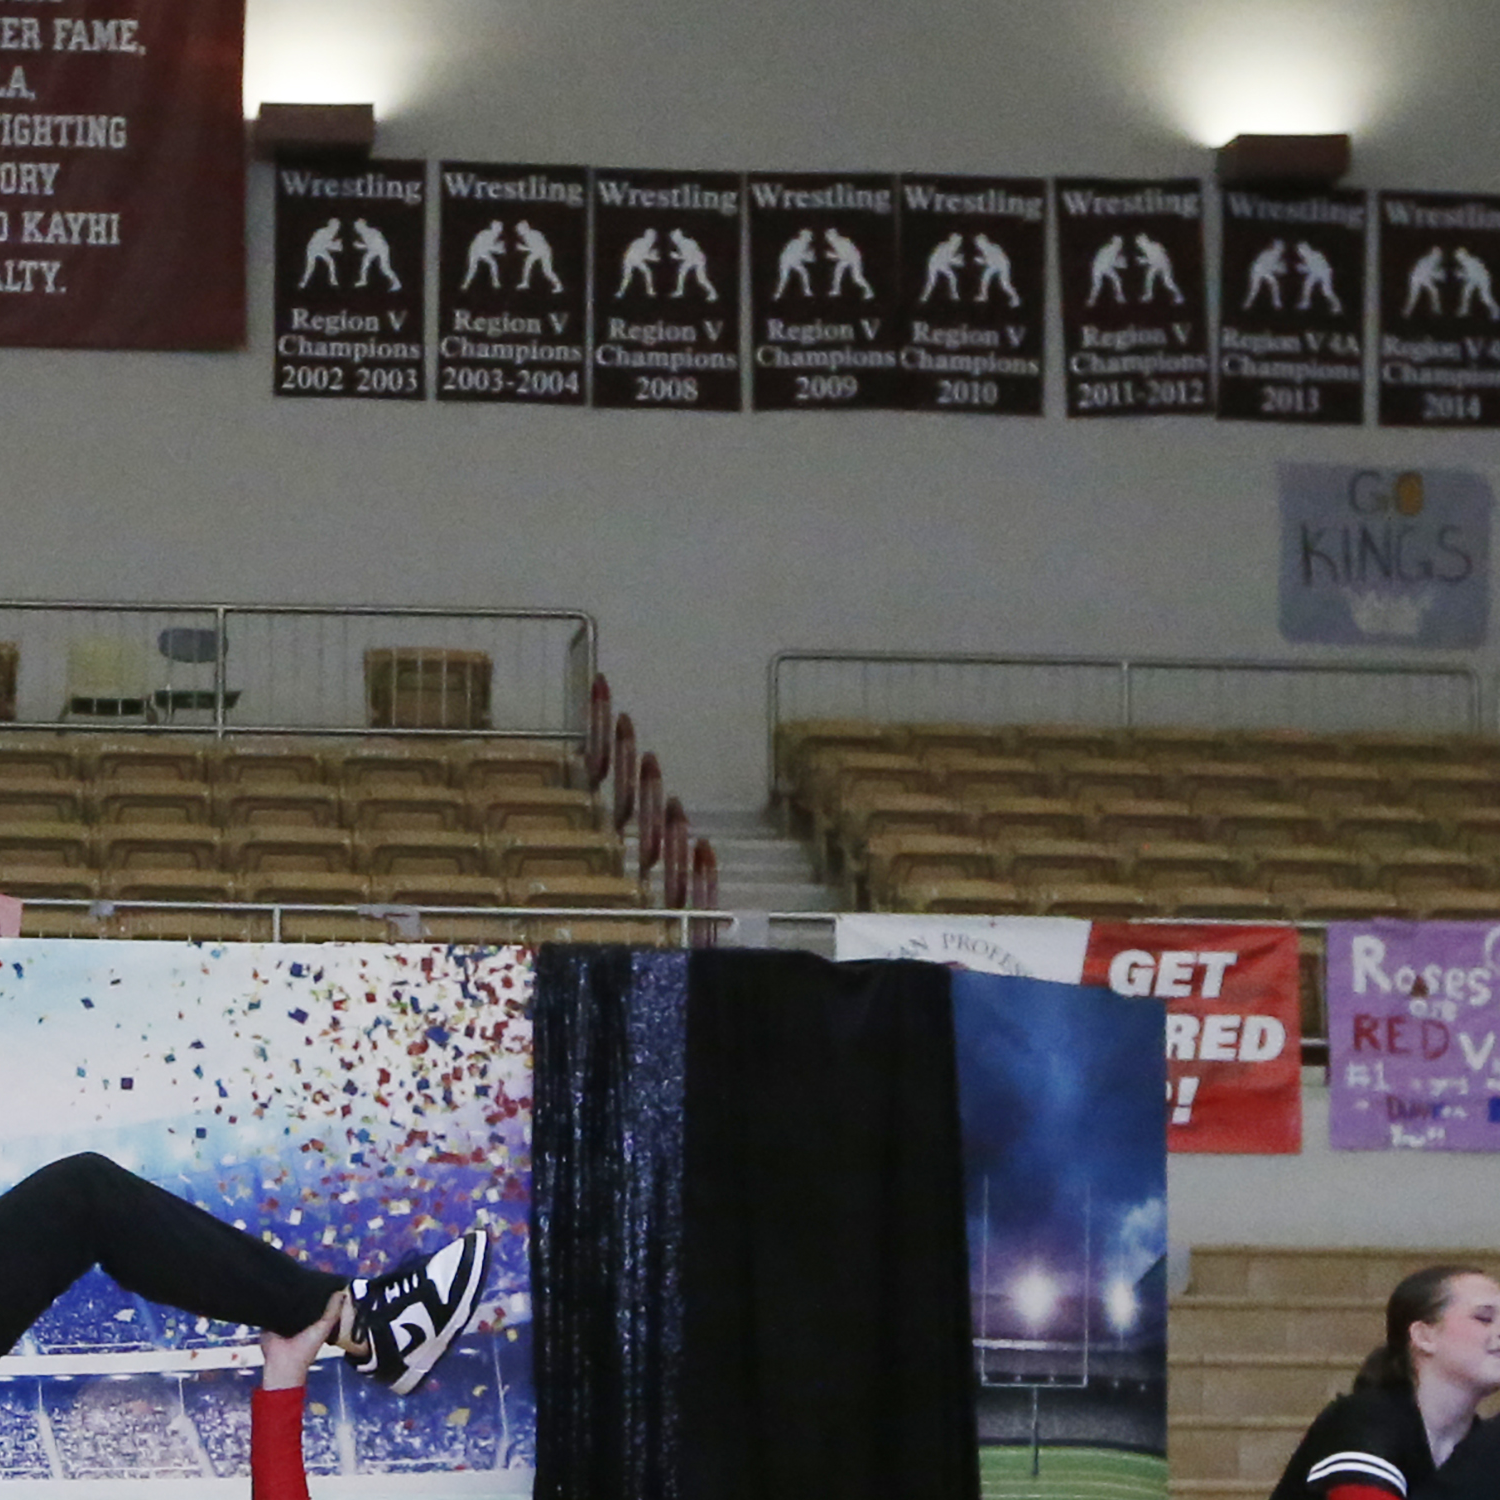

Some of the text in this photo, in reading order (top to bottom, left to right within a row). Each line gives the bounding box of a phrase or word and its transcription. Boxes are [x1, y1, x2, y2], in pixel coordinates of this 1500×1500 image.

[53, 18, 146, 56] FAME,
[281, 171, 422, 206] Wrestling
[442, 172, 583, 207] Wrestling
[598, 180, 738, 216] Wrestling
[750, 182, 891, 213] Wrestling
[903, 184, 1043, 221] Wrestling
[1061, 189, 1203, 218] Wrestling
[21, 210, 120, 245] KAYHI
[1228, 192, 1368, 233] Wrestling
[291, 307, 408, 335] Region V
[452, 309, 569, 339] Region V
[609, 317, 724, 346] Region V
[767, 318, 881, 345] Region V
[912, 320, 1027, 350] Region V
[277, 334, 421, 364] Champions
[439, 335, 583, 365] Champions
[1082, 323, 1193, 351] Region V
[595, 343, 738, 373] Champions
[754, 345, 897, 372] Champions
[899, 348, 1040, 376] Champions
[1069, 352, 1209, 376] Champions
[1220, 353, 1363, 384] Champions
[282, 364, 418, 392] 2002 2003
[442, 365, 579, 394] 2003-2004
[636, 376, 699, 401] 2008
[796, 375, 858, 400] 2009
[938, 379, 998, 404] 2010
[1078, 380, 1203, 409] 2011-2012
[1350, 470, 1424, 518] GO
[1300, 522, 1474, 586] KINGS
[1109, 949, 1238, 998] GET
[1166, 1014, 1286, 1063] RED
[1353, 1015, 1451, 1061] RED
